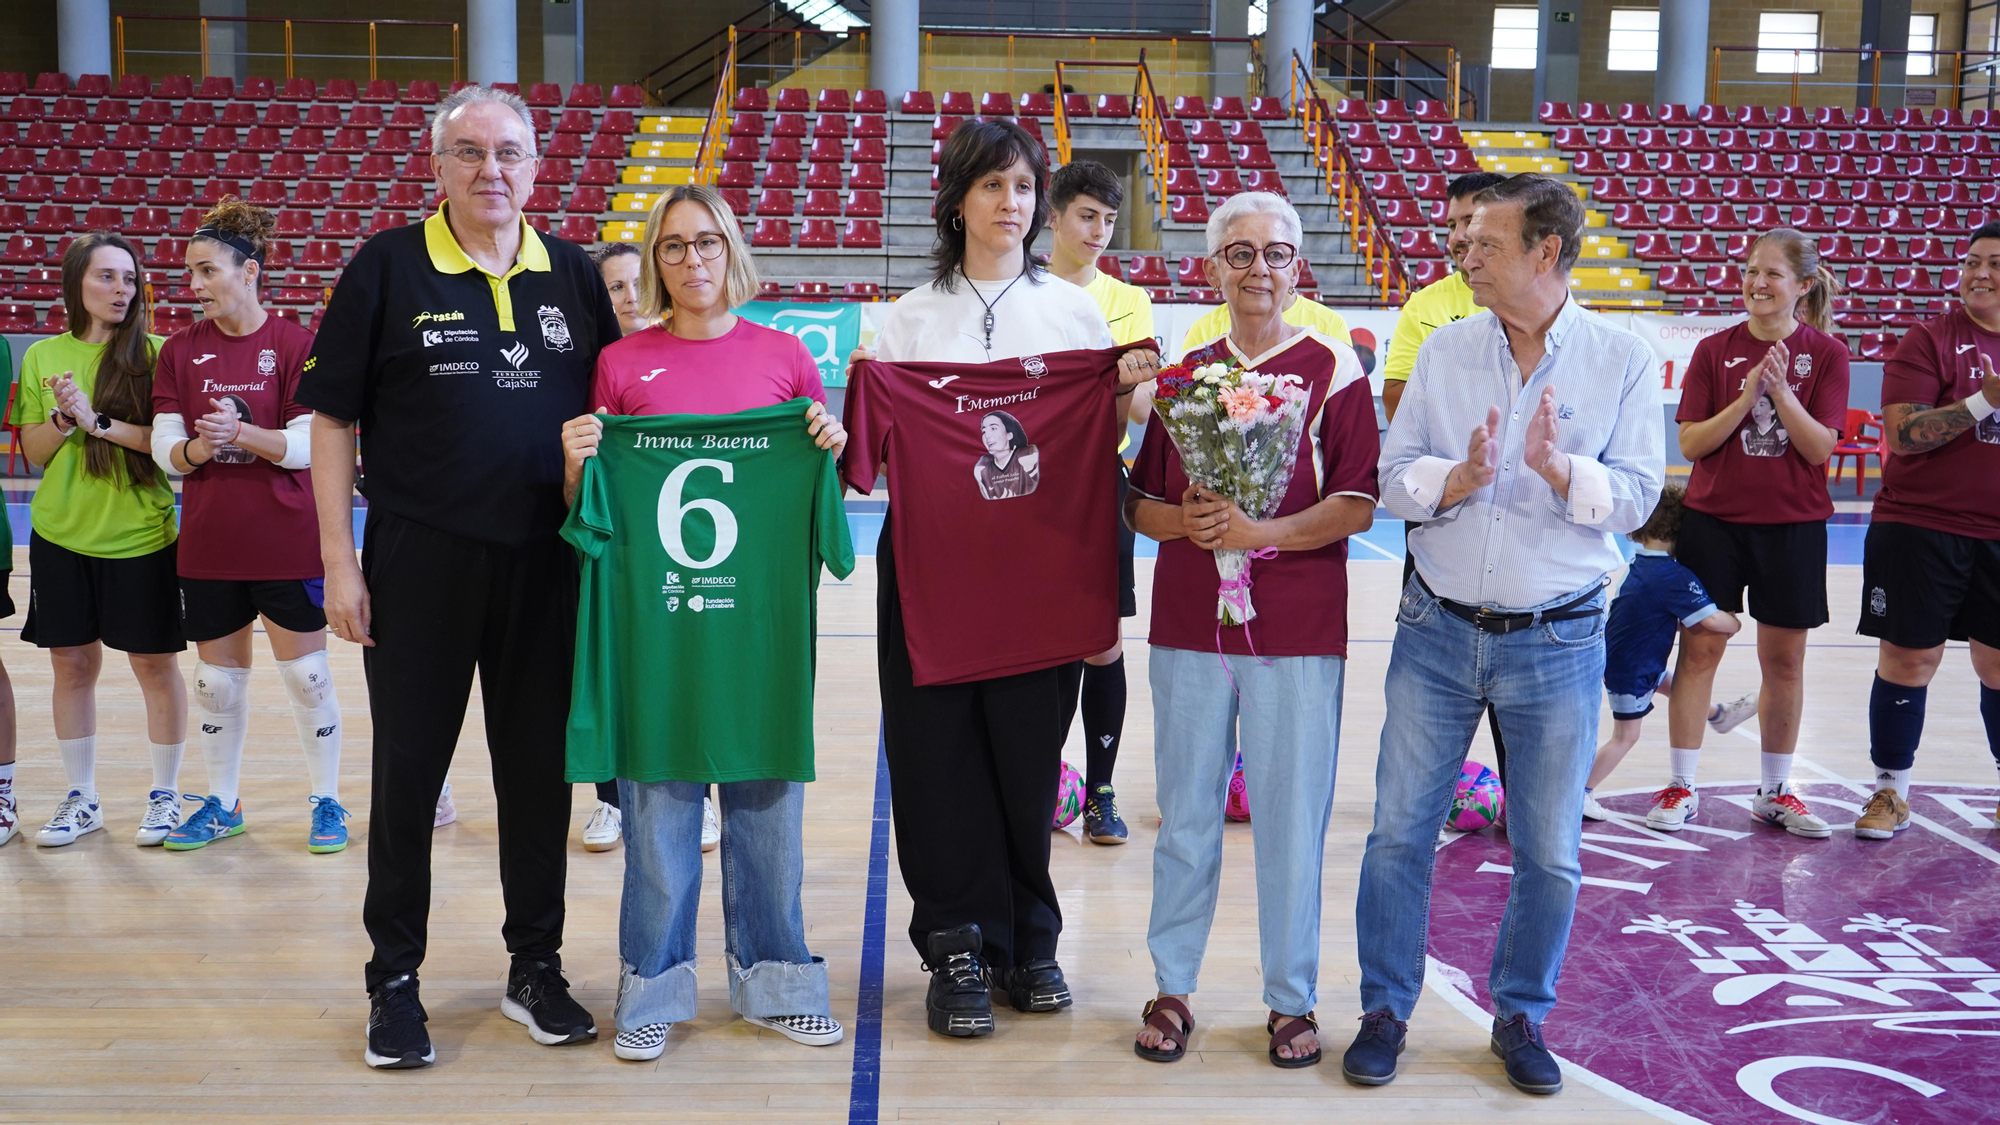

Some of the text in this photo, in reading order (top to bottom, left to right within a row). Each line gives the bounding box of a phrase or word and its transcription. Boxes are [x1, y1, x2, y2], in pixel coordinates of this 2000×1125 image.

[439, 361, 480, 372] IMDECO
[210, 380, 268, 393] Memorial
[496, 378, 539, 391] CajaSur
[966, 385, 1041, 412] Memorial
[632, 432, 770, 449] Inma Baena
[657, 458, 739, 570] 6
[701, 576, 736, 585] IMDECO
